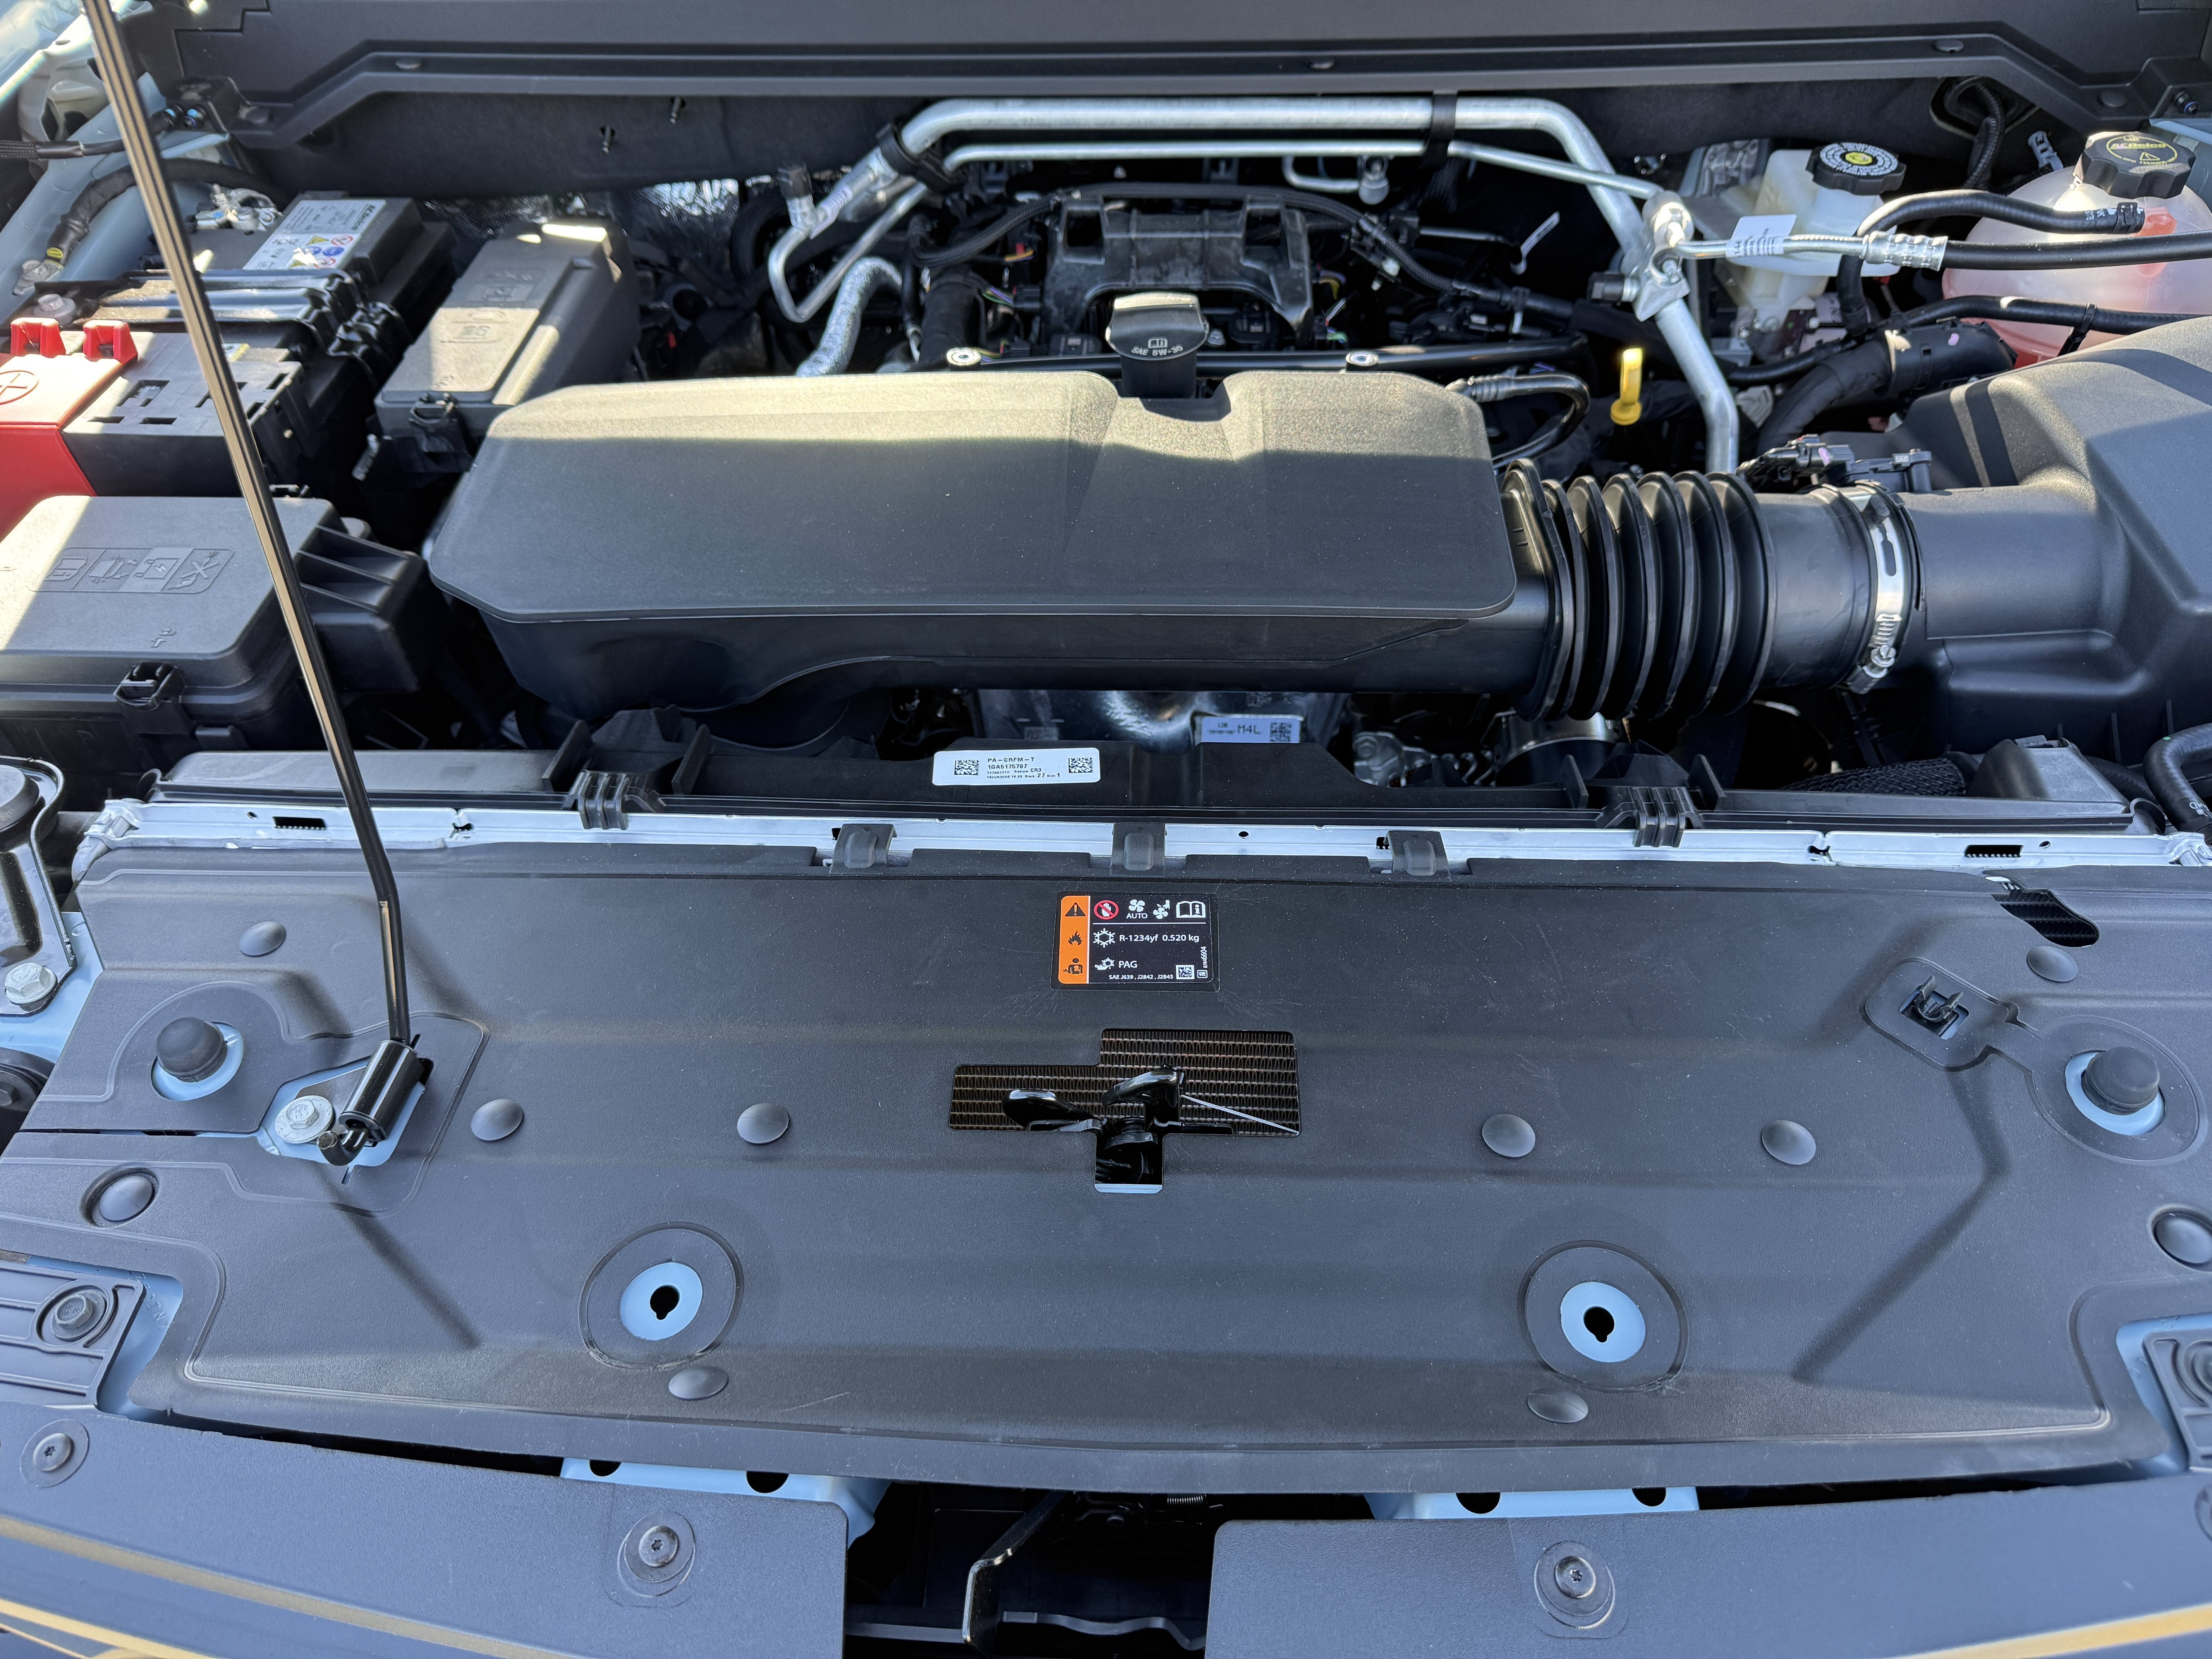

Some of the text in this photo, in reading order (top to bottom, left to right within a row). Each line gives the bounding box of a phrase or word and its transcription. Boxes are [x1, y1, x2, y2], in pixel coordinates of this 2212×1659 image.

[1131, 345, 1184, 356] SAE 5W-30
[1237, 724, 1261, 735] M4L
[1119, 934, 1159, 943] R-1234yf
[1188, 934, 1200, 943] kg
